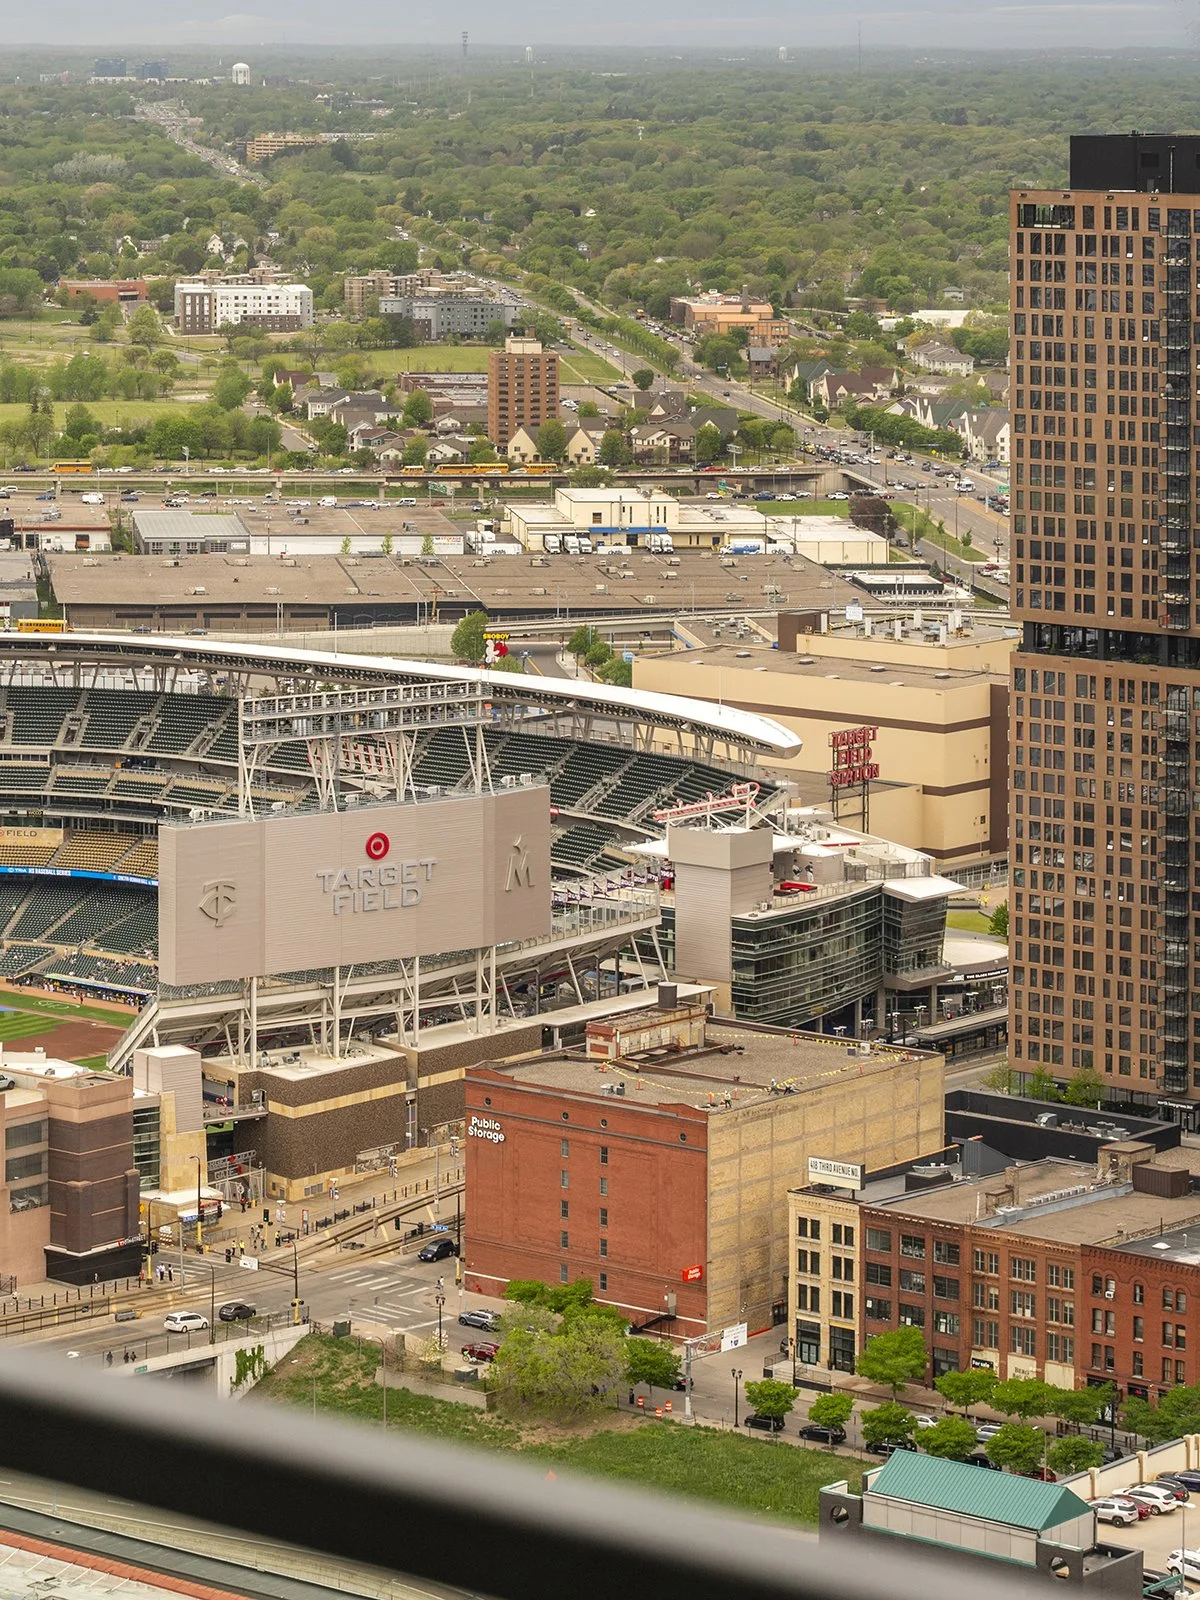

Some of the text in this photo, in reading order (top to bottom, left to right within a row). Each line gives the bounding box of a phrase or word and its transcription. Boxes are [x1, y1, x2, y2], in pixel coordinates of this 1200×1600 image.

[832, 726, 878, 748] TARGET
[837, 747, 872, 766] FIELD
[831, 764, 879, 786] STATION
[316, 858, 438, 893] TARGET
[332, 886, 423, 915] FIELD
[471, 1116, 501, 1131] Public
[468, 1126, 505, 1143] Storage
[819, 1161, 833, 1173] THIRD
[833, 1164, 851, 1176] AVENUE
